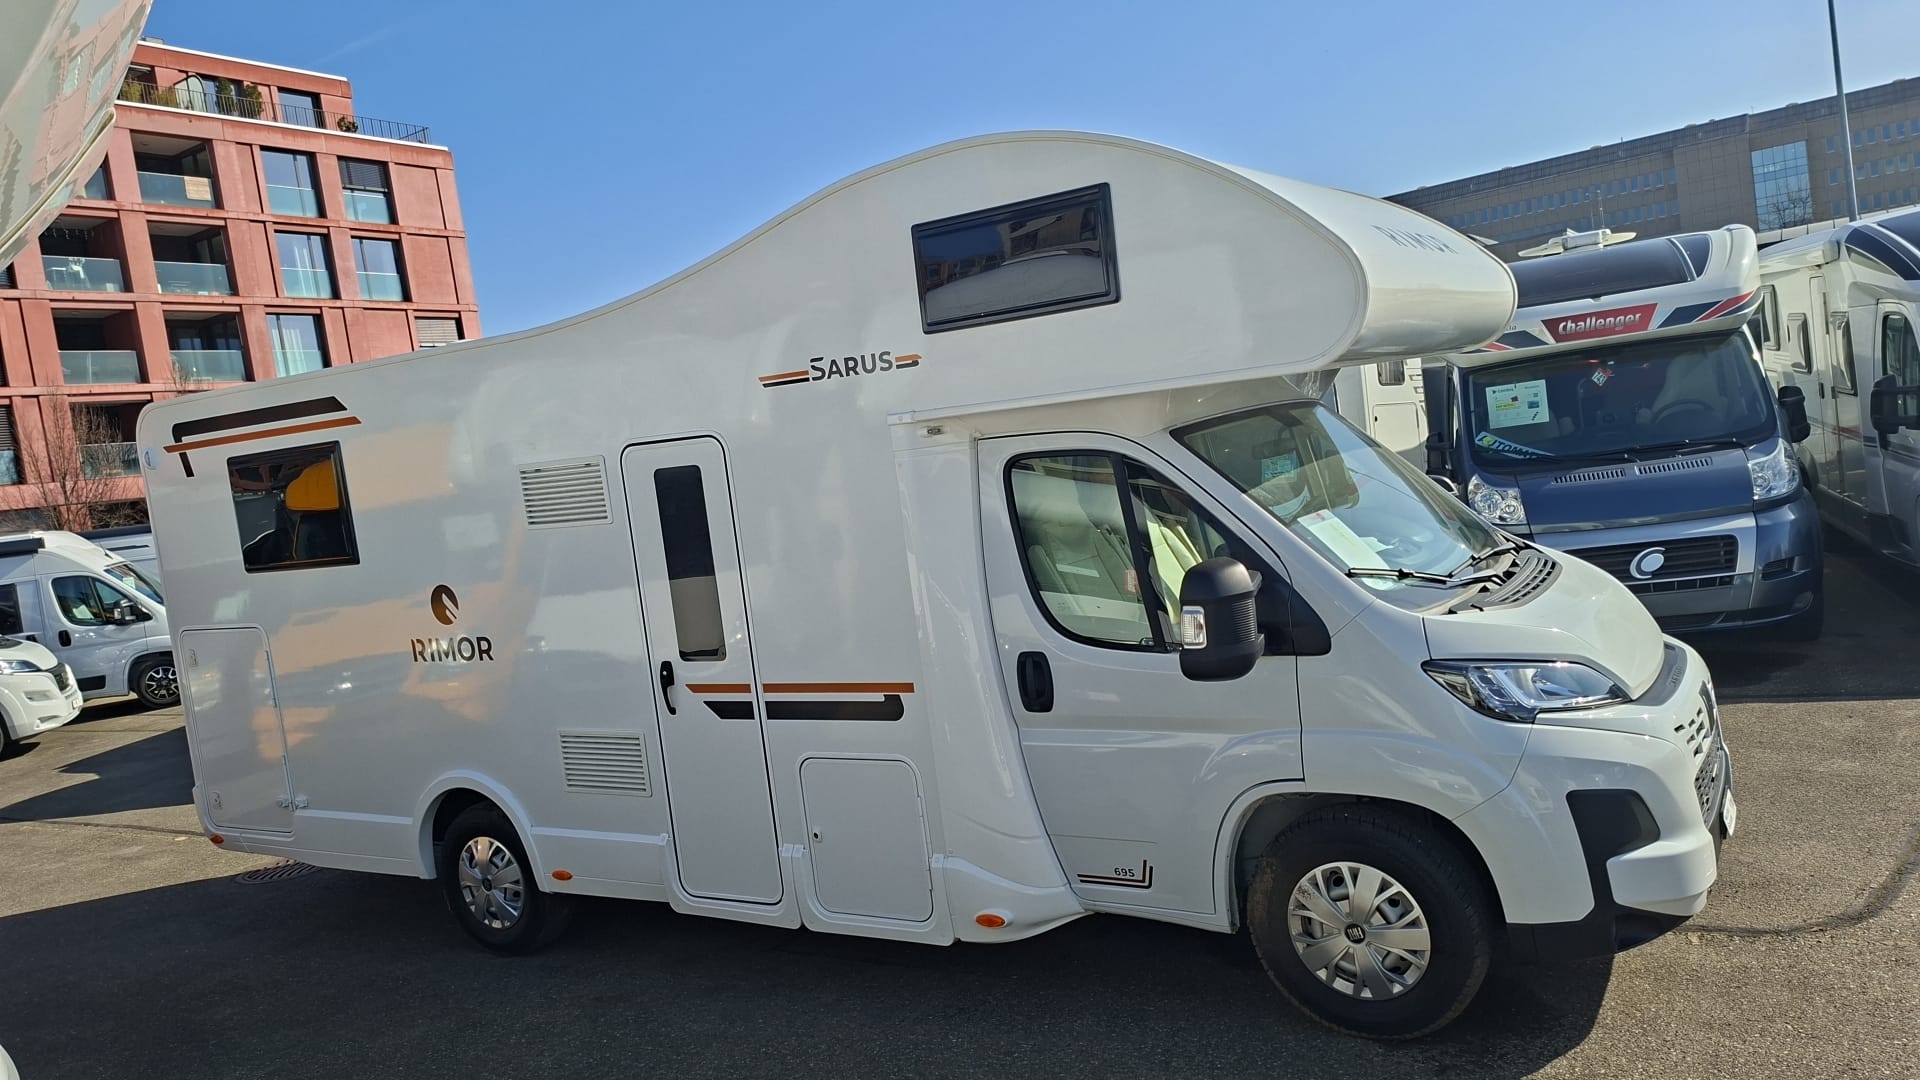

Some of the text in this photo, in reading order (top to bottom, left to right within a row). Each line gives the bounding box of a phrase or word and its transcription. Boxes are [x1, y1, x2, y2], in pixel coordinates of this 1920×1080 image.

[1371, 225, 1459, 254] RIMOR
[1558, 313, 1641, 335] Challenger
[810, 351, 893, 381] SARUS
[410, 637, 494, 662] RIMOR
[1114, 867, 1135, 878] 695
